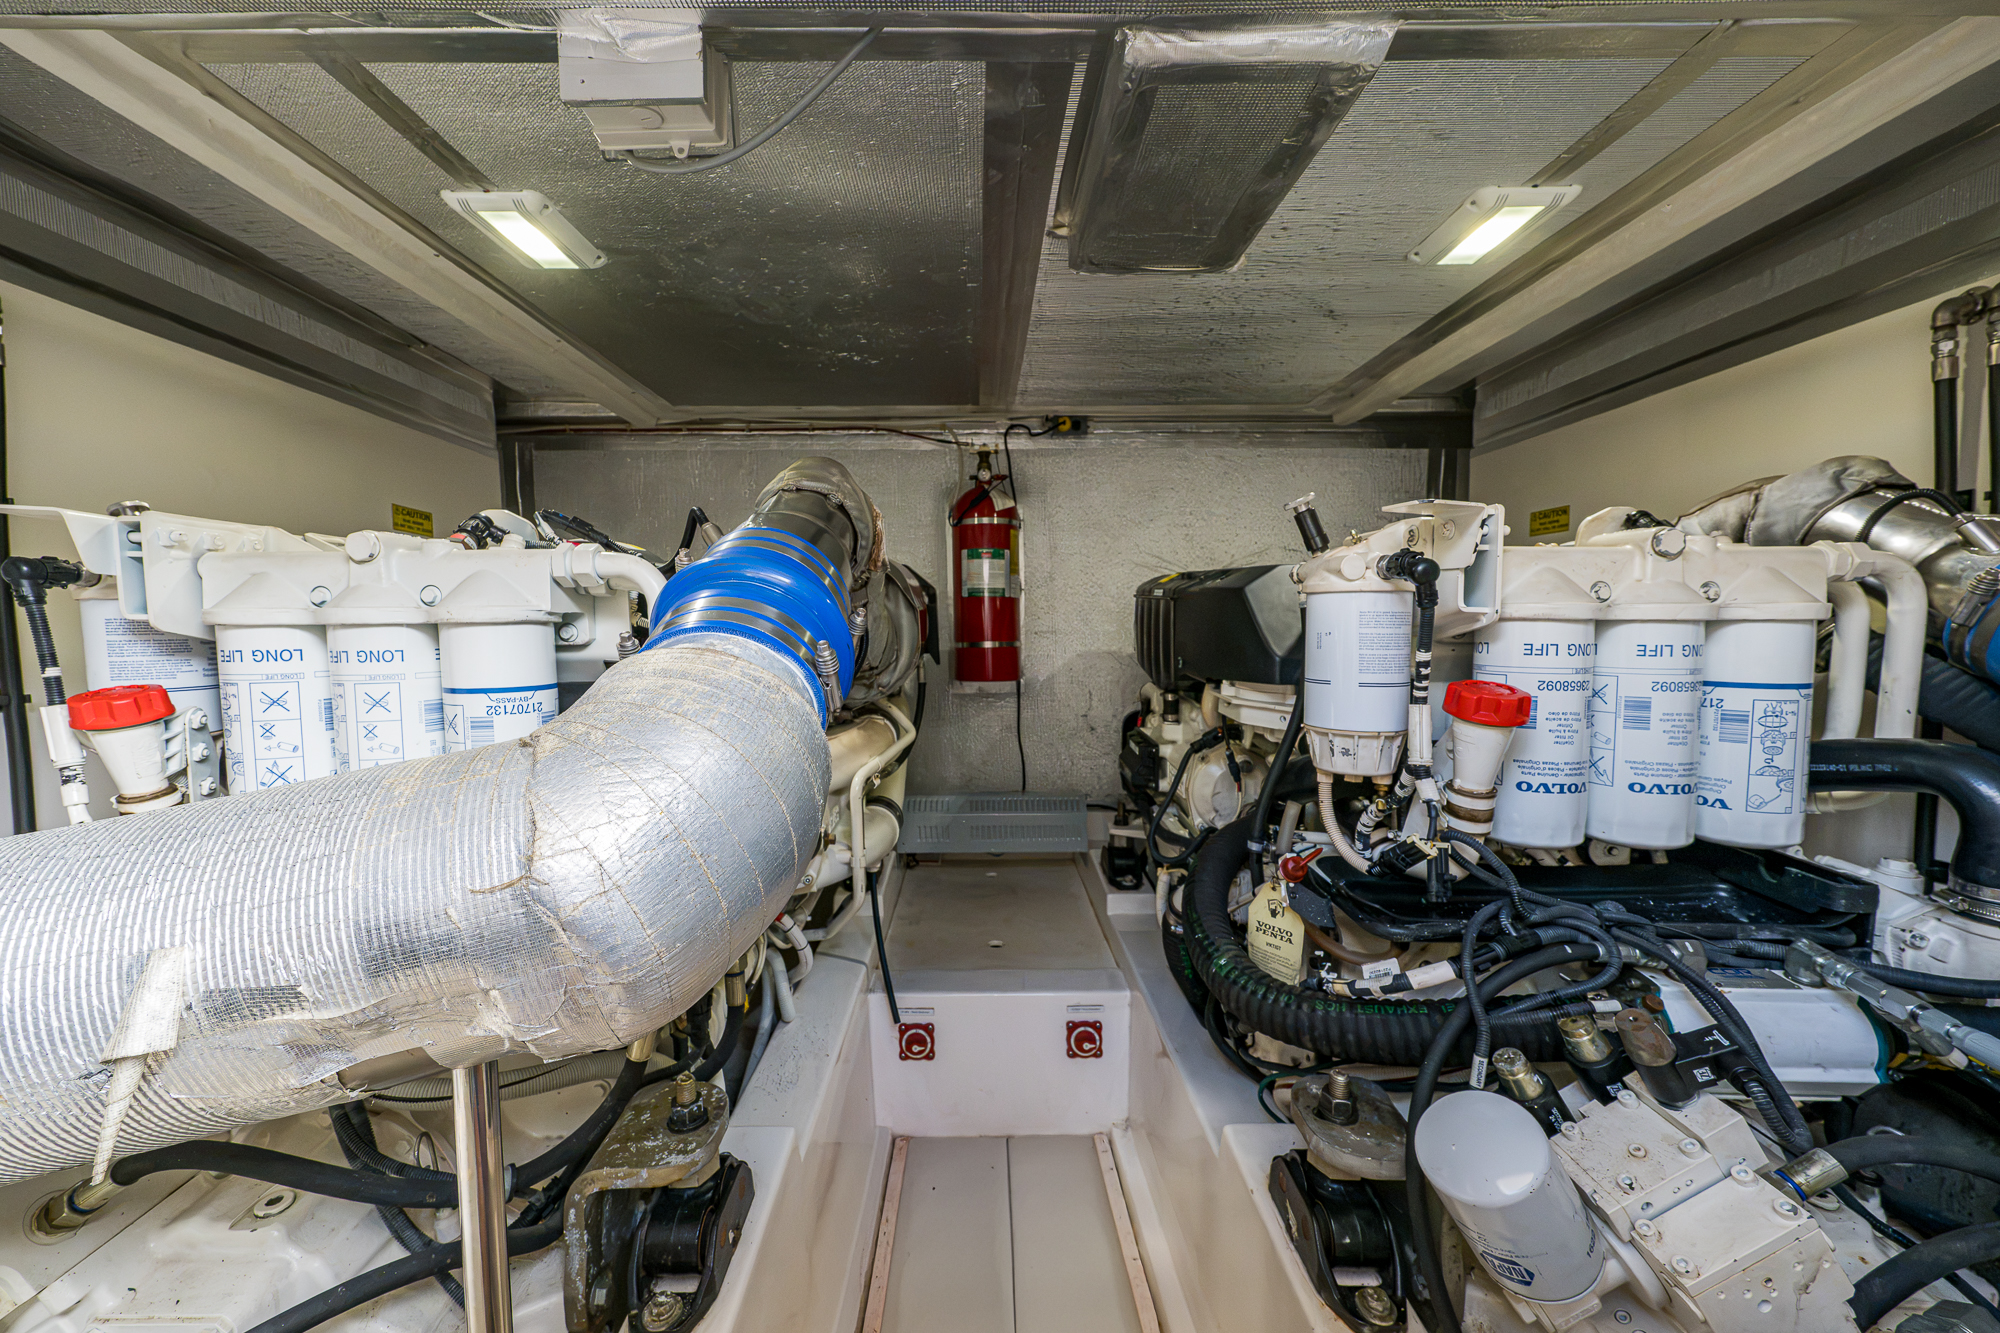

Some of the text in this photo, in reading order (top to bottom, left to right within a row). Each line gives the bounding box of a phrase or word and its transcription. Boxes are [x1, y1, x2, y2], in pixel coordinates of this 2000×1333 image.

[401, 508, 431, 522] CAUTION
[1538, 508, 1568, 520] CAUTION
[220, 649, 303, 663] LONG LIFE
[329, 649, 405, 663] LONG LIFE
[1523, 643, 1598, 657] LONG LIFE
[1636, 644, 1704, 657] ONG LIFE
[1537, 680, 1590, 691] 23658092
[1651, 681, 1703, 692] 23658092
[495, 695, 529, 704] BY-PASS
[485, 702, 543, 716] 21707132
[1624, 759, 1654, 767] Originales
[1515, 780, 1588, 795] VOLVO
[1627, 782, 1698, 795] VOLVO
[1255, 919, 1294, 938] VOLVO
[1254, 926, 1295, 946] PENTA
[1356, 1004, 1429, 1015] EXHAUST
[1475, 1059, 1485, 1088] SECONDARY
[1485, 1255, 1527, 1281] NAPA
